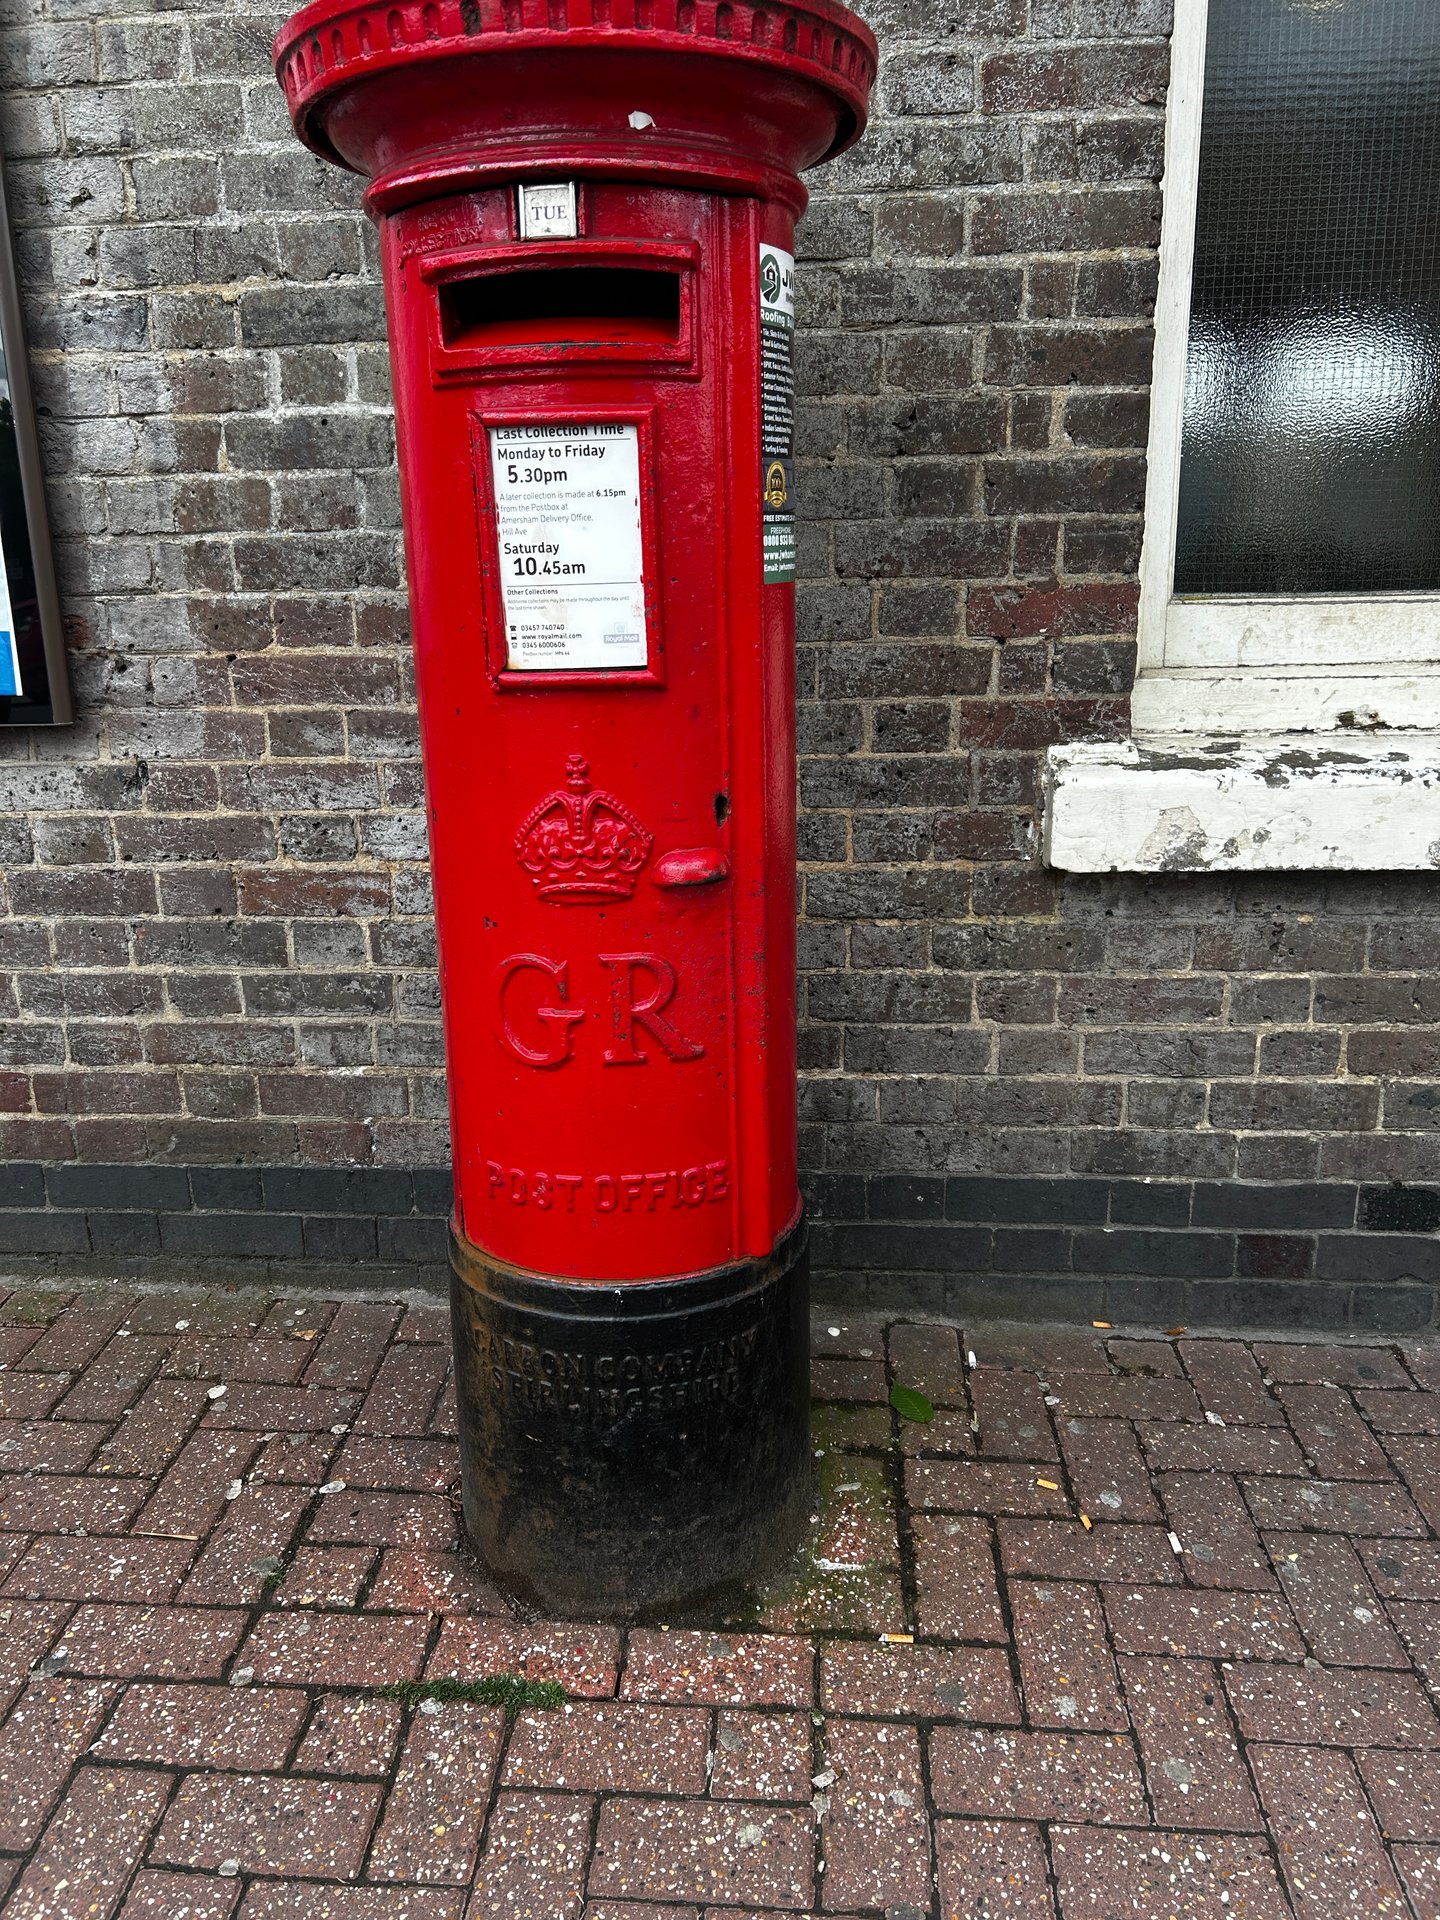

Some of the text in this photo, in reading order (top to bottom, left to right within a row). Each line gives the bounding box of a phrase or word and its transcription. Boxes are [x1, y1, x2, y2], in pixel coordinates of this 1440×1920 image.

[531, 204, 567, 221] TUE
[760, 308, 785, 328] Roofing
[496, 425, 624, 440] Last Collection Time
[497, 444, 606, 461] Monday to Friday
[507, 464, 568, 485] 5.30pm
[499, 488, 626, 501] A later collection is made at 6.15pm
[500, 502, 568, 513] from the Postbox at
[501, 515, 539, 525] Amersham
[540, 513, 570, 524] Delivery
[763, 514, 775, 522] FREE
[502, 527, 528, 536] Hill Ave
[503, 542, 560, 555] Saturday
[513, 557, 586, 576] 10.45am
[507, 588, 559, 596] Other Collections
[541, 623, 565, 631] 740740
[521, 632, 583, 641] www.royalmail.com
[522, 641, 566, 649] 0345 6000606
[486, 1159, 730, 1214] POST OFFICE
[595, 1325, 760, 1383] COMPANY
